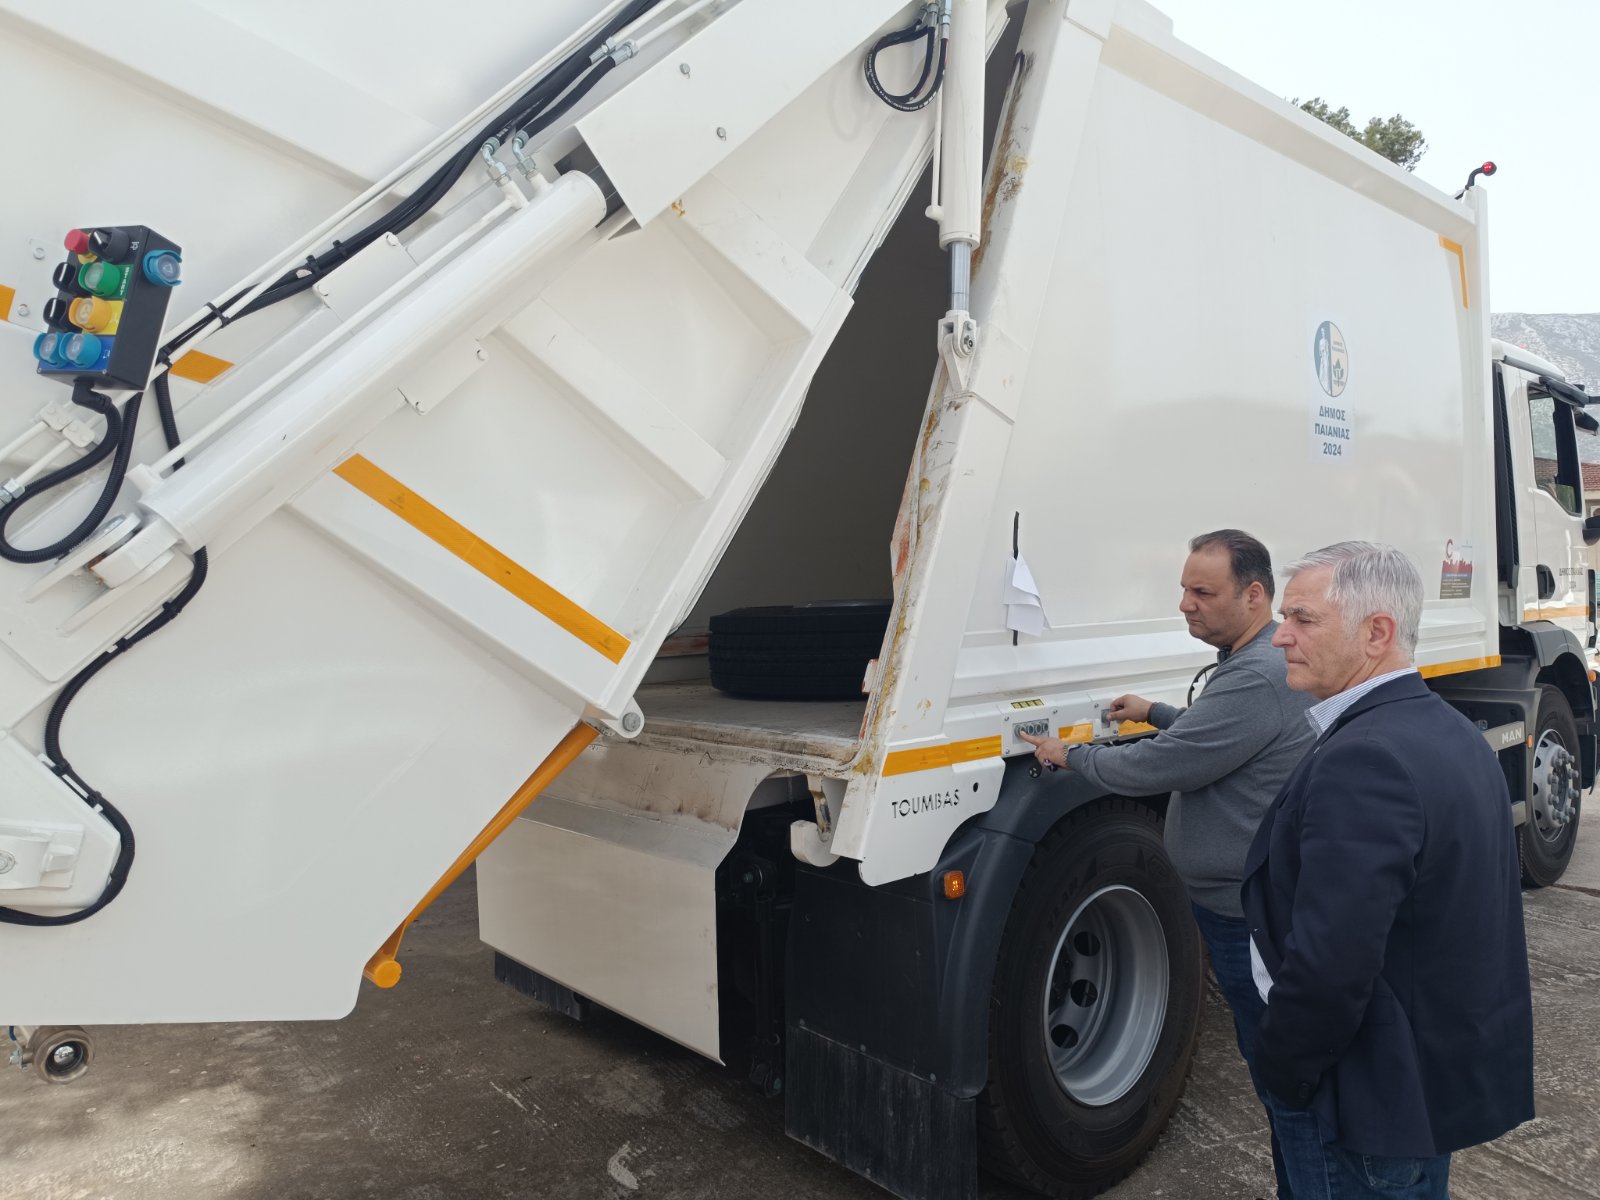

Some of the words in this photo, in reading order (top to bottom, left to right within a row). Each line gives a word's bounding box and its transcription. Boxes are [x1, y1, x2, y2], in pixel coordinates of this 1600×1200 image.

[1319, 405, 1346, 421] ΔΗΜΟΣ
[1314, 423, 1350, 440] ΠΑΙΑΝΙΑΣ
[1323, 442, 1342, 456] 2024
[1501, 728, 1522, 745] MAN
[892, 789, 960, 818] TOUMBAS
